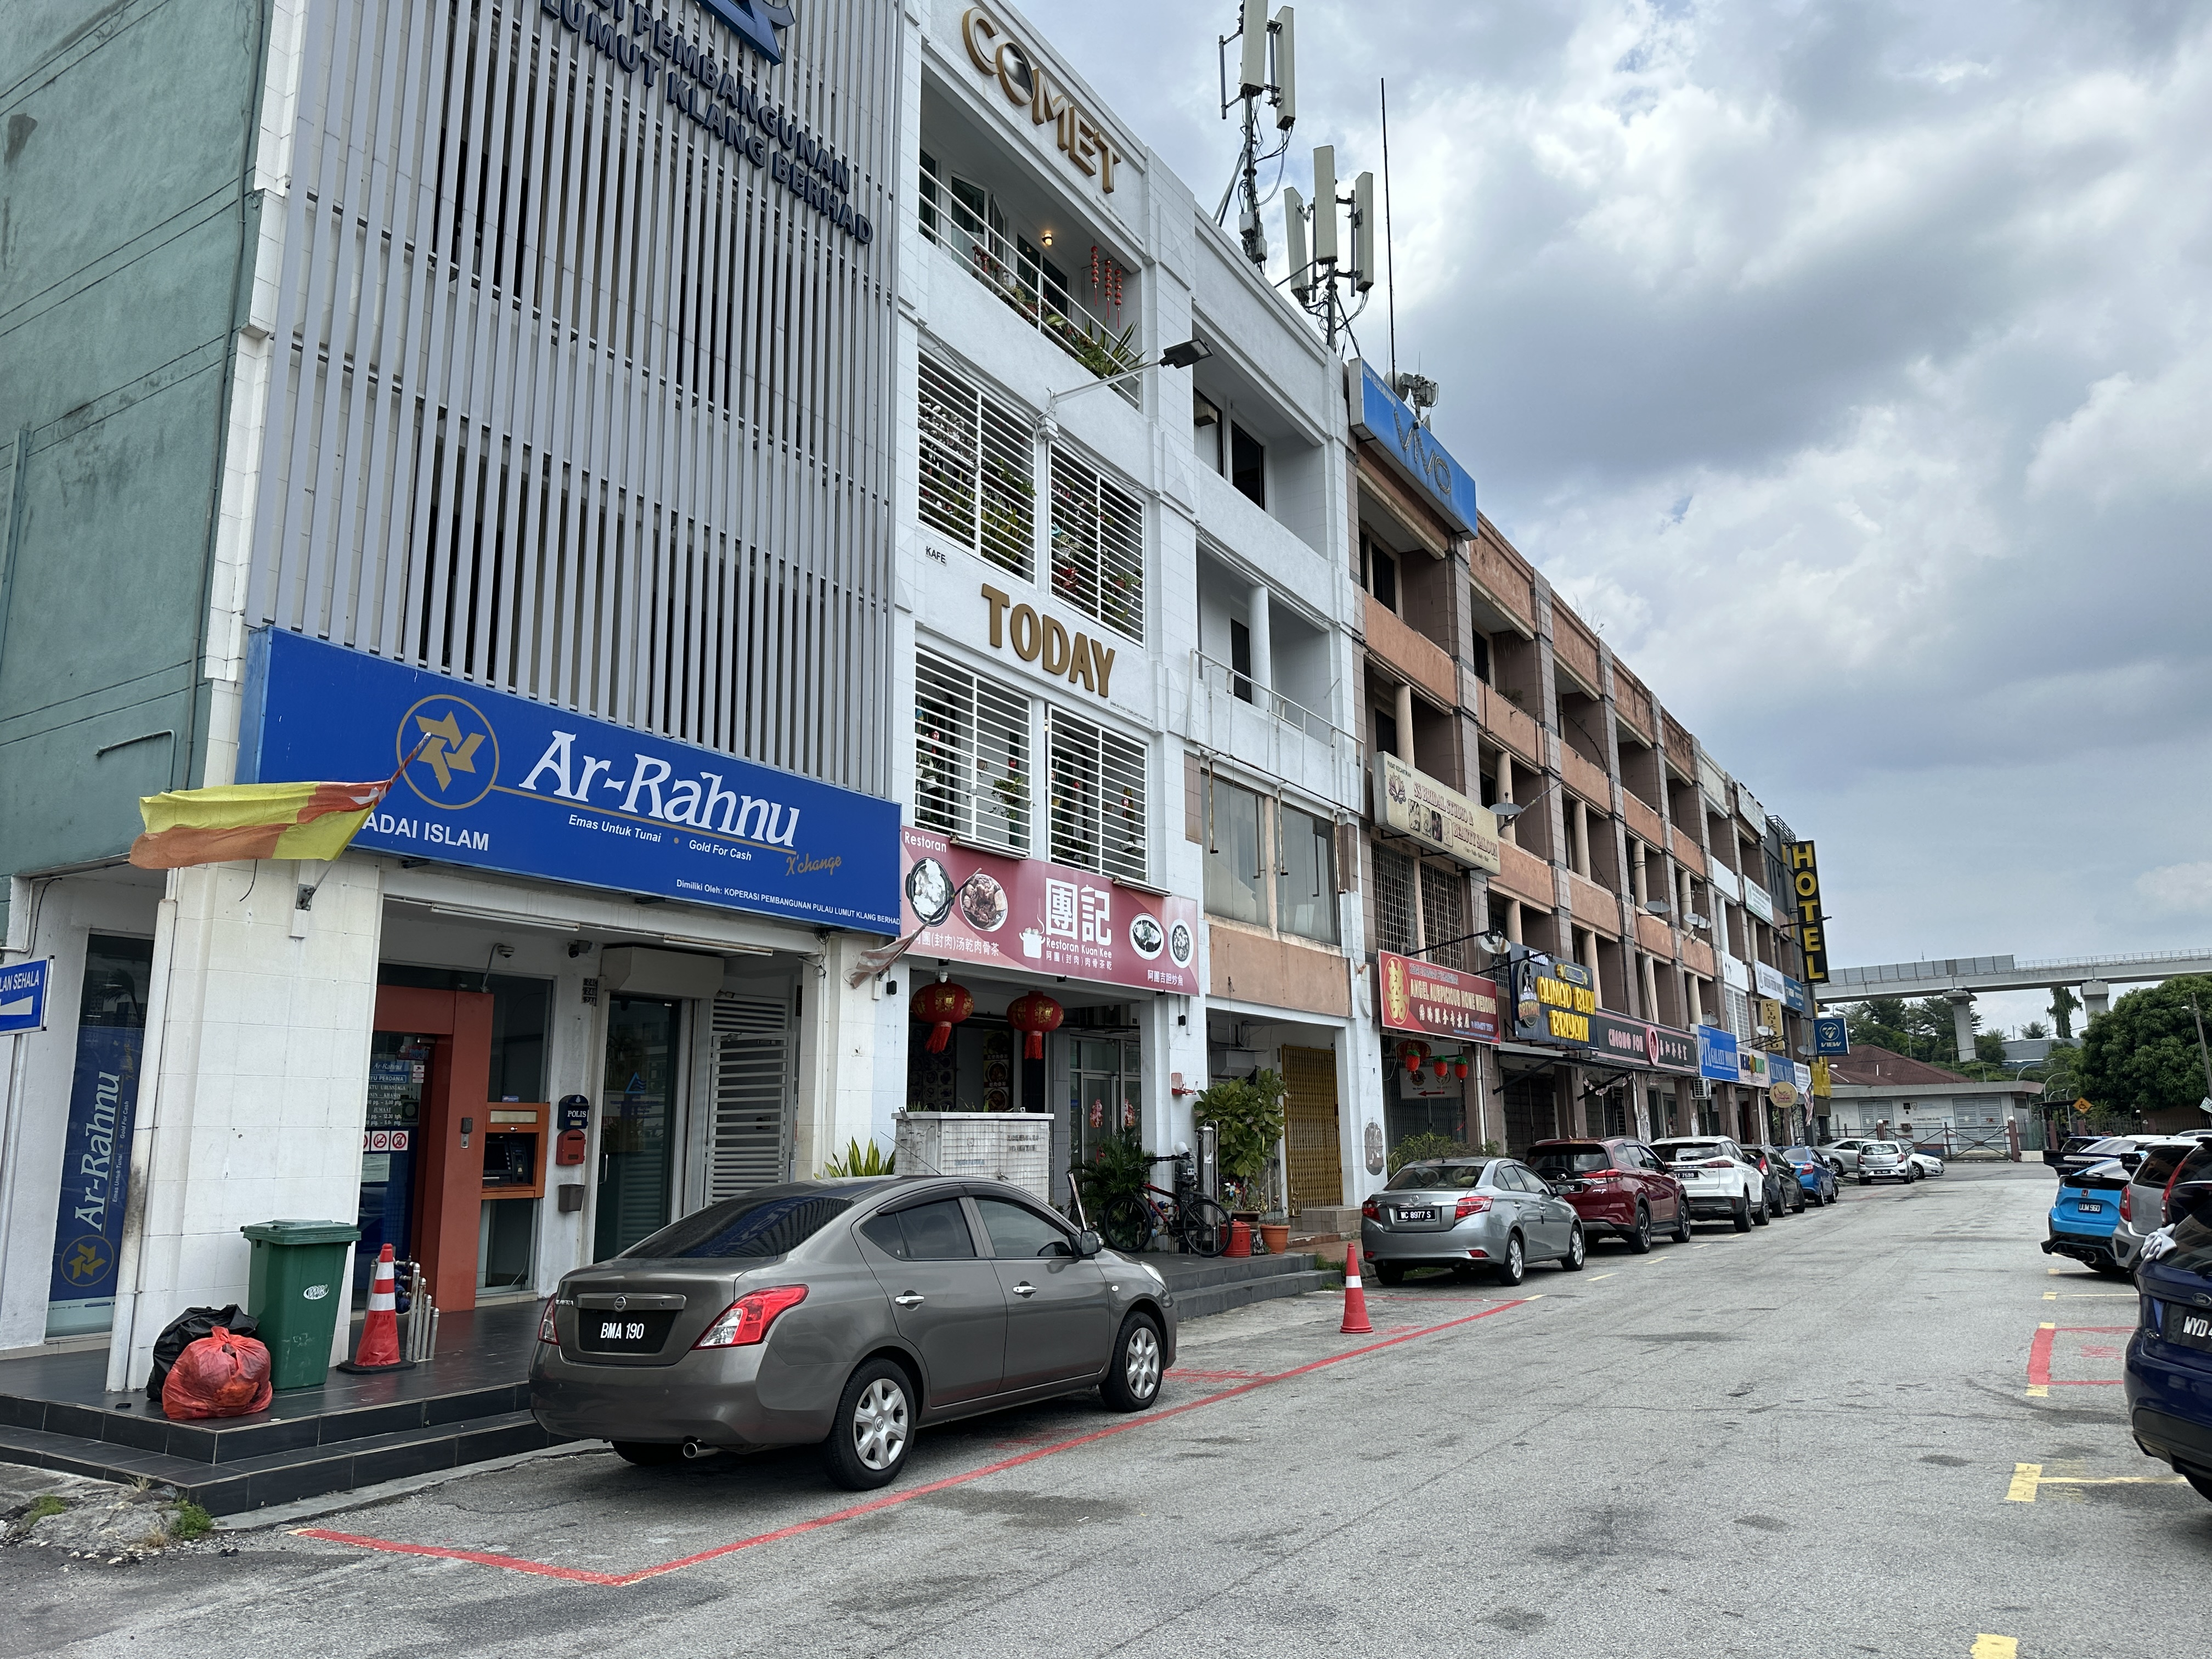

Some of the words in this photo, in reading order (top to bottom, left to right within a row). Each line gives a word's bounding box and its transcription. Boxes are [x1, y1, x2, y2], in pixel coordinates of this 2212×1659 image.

[634, 3, 849, 194] PEMBANGUNAN
[962, 7, 1121, 194] COMET
[667, 72, 765, 168] KLANG
[771, 151, 873, 245] BERHAD
[926, 546, 946, 563] KAFE
[981, 583, 1116, 698] TODAY
[519, 730, 800, 848] Ar-Rahnu
[1421, 785, 1446, 812] BRIDAL
[1446, 799, 1468, 823] STUDIO
[363, 812, 416, 839] ADAI
[424, 822, 489, 851] ISLAM
[568, 814, 598, 831] Emas
[601, 821, 632, 837] Untuk
[634, 827, 662, 844] Tunai
[904, 831, 947, 853] Restoran
[1453, 822, 1476, 847] BEAUTY
[1476, 833, 1498, 858] SALOON
[689, 839, 712, 853] Gold
[713, 844, 729, 856] For
[730, 847, 752, 861] Cash
[676, 879, 703, 891] Dimiliki
[704, 884, 723, 894] Oleh:
[724, 887, 760, 901] KOPERASI
[761, 894, 811, 910] PEMBANGUNAN
[812, 903, 833, 914] PULAU
[834, 907, 855, 918] LUMUT
[856, 911, 876, 922] KLANG
[877, 915, 900, 926] BERHAD
[1046, 877, 1111, 946] 團記
[1792, 843, 1825, 980] HOTEL
[1046, 937, 1079, 953] Restoran
[1081, 944, 1098, 956] Kuan
[1099, 947, 1112, 958] Kee
[13, 969, 40, 990] SEHALA
[1410, 979, 1430, 1001] ANGEL
[1430, 983, 1461, 1007] AUSPICIOUS
[1461, 990, 1476, 1011] HOME
[1476, 994, 1497, 1015] WEDDING
[1536, 976, 1572, 1009] AHMAD
[1573, 986, 1596, 1015] BHAI
[1549, 1009, 1589, 1042] BRIYANI
[1608, 1029, 1631, 1050] CHEONG
[75, 1071, 120, 1232] Ar-Rahnu
[1410, 1211, 1425, 1219] 8977
[600, 1323, 622, 1339] BMA
[626, 1323, 645, 1339] 190
[2183, 1316, 2208, 1338] WYD
